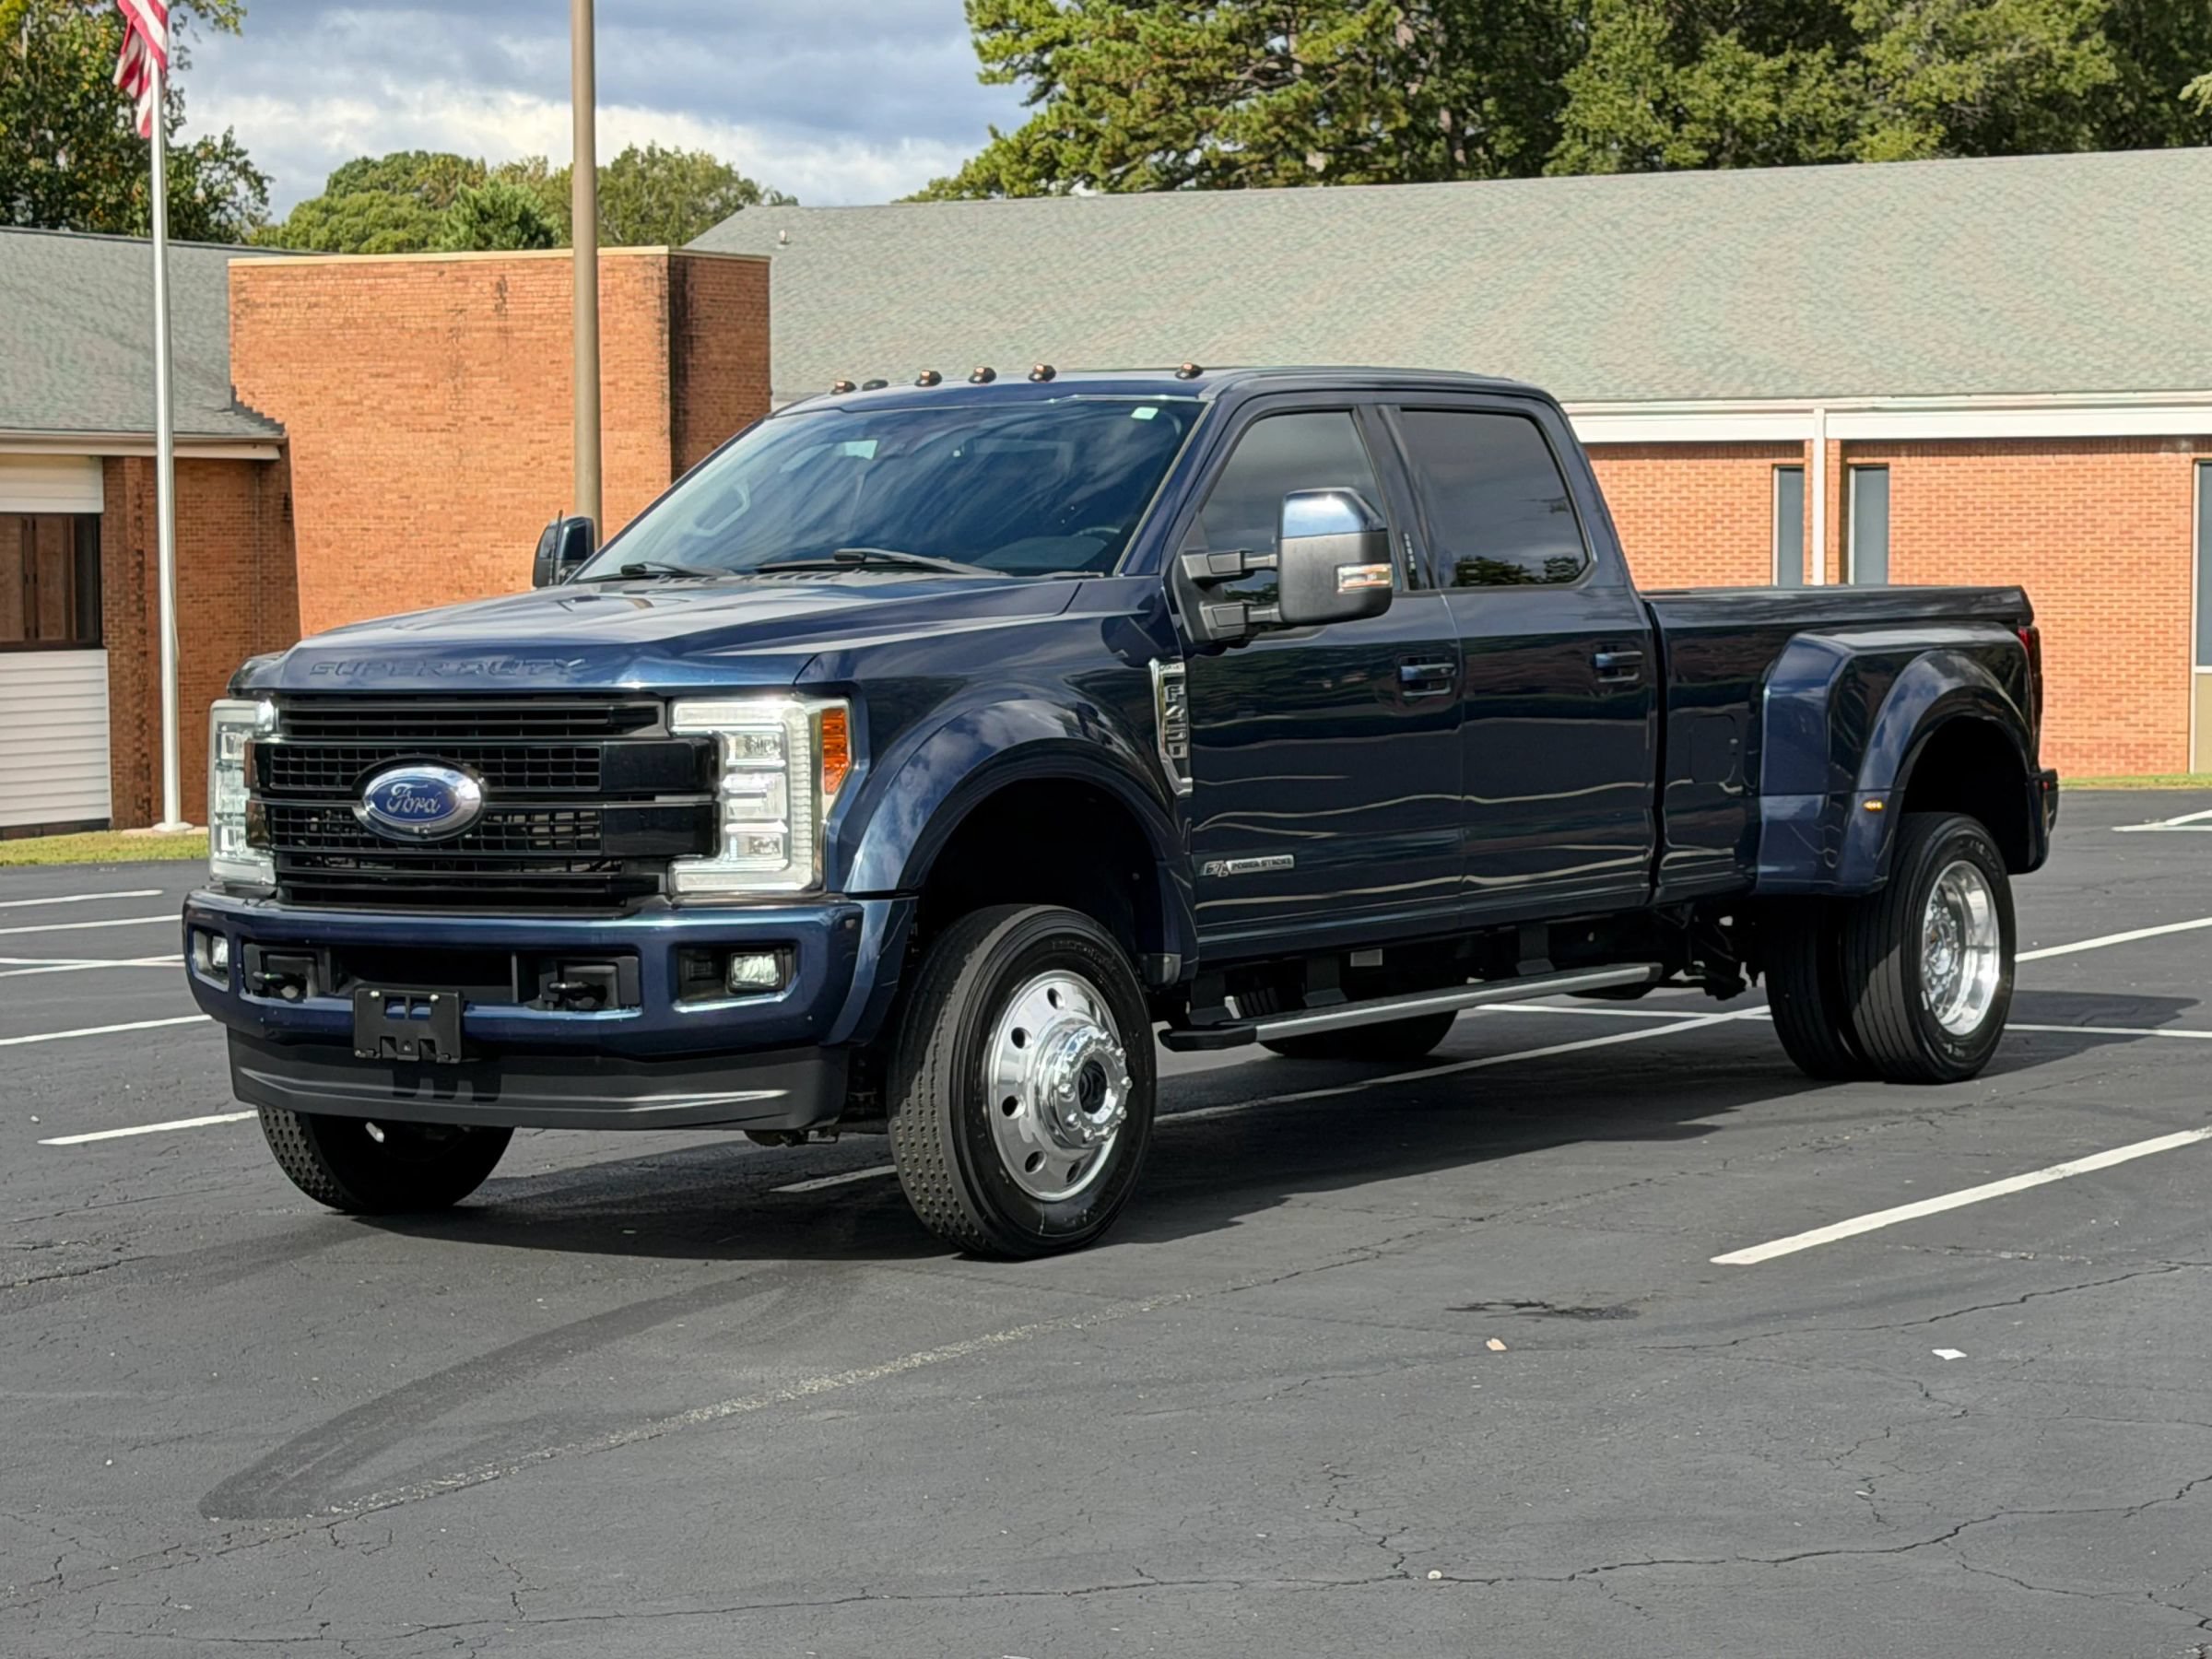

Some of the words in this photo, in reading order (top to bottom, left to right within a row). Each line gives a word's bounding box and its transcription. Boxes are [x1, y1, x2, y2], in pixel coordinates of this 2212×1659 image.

[310, 660, 446, 677] SUPER
[458, 659, 587, 677] DUTY
[386, 783, 441, 813] Ford
